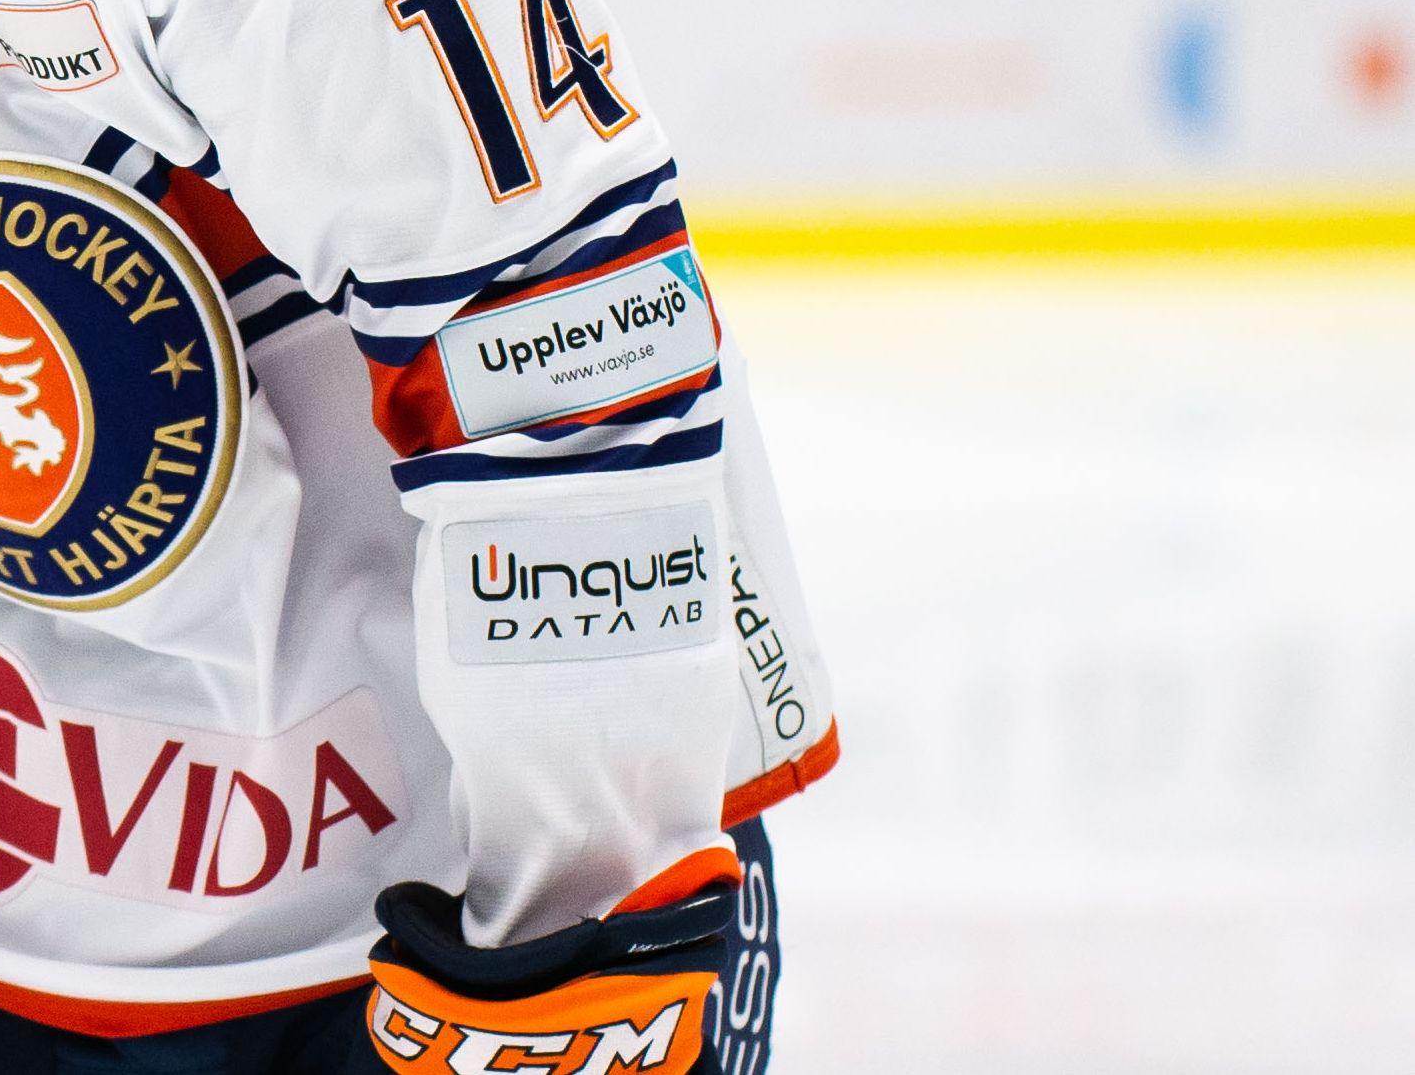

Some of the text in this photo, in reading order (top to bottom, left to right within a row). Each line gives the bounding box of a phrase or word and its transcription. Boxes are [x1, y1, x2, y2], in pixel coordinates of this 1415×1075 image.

[478, 281, 686, 375] Upplev Växjö
[550, 342, 655, 385] www.vaxjo.se
[49, 415, 207, 586] HJÄRTA
[487, 600, 702, 641] DATA AB
[59, 719, 398, 898] VIDA
[373, 983, 689, 1075] CCM
